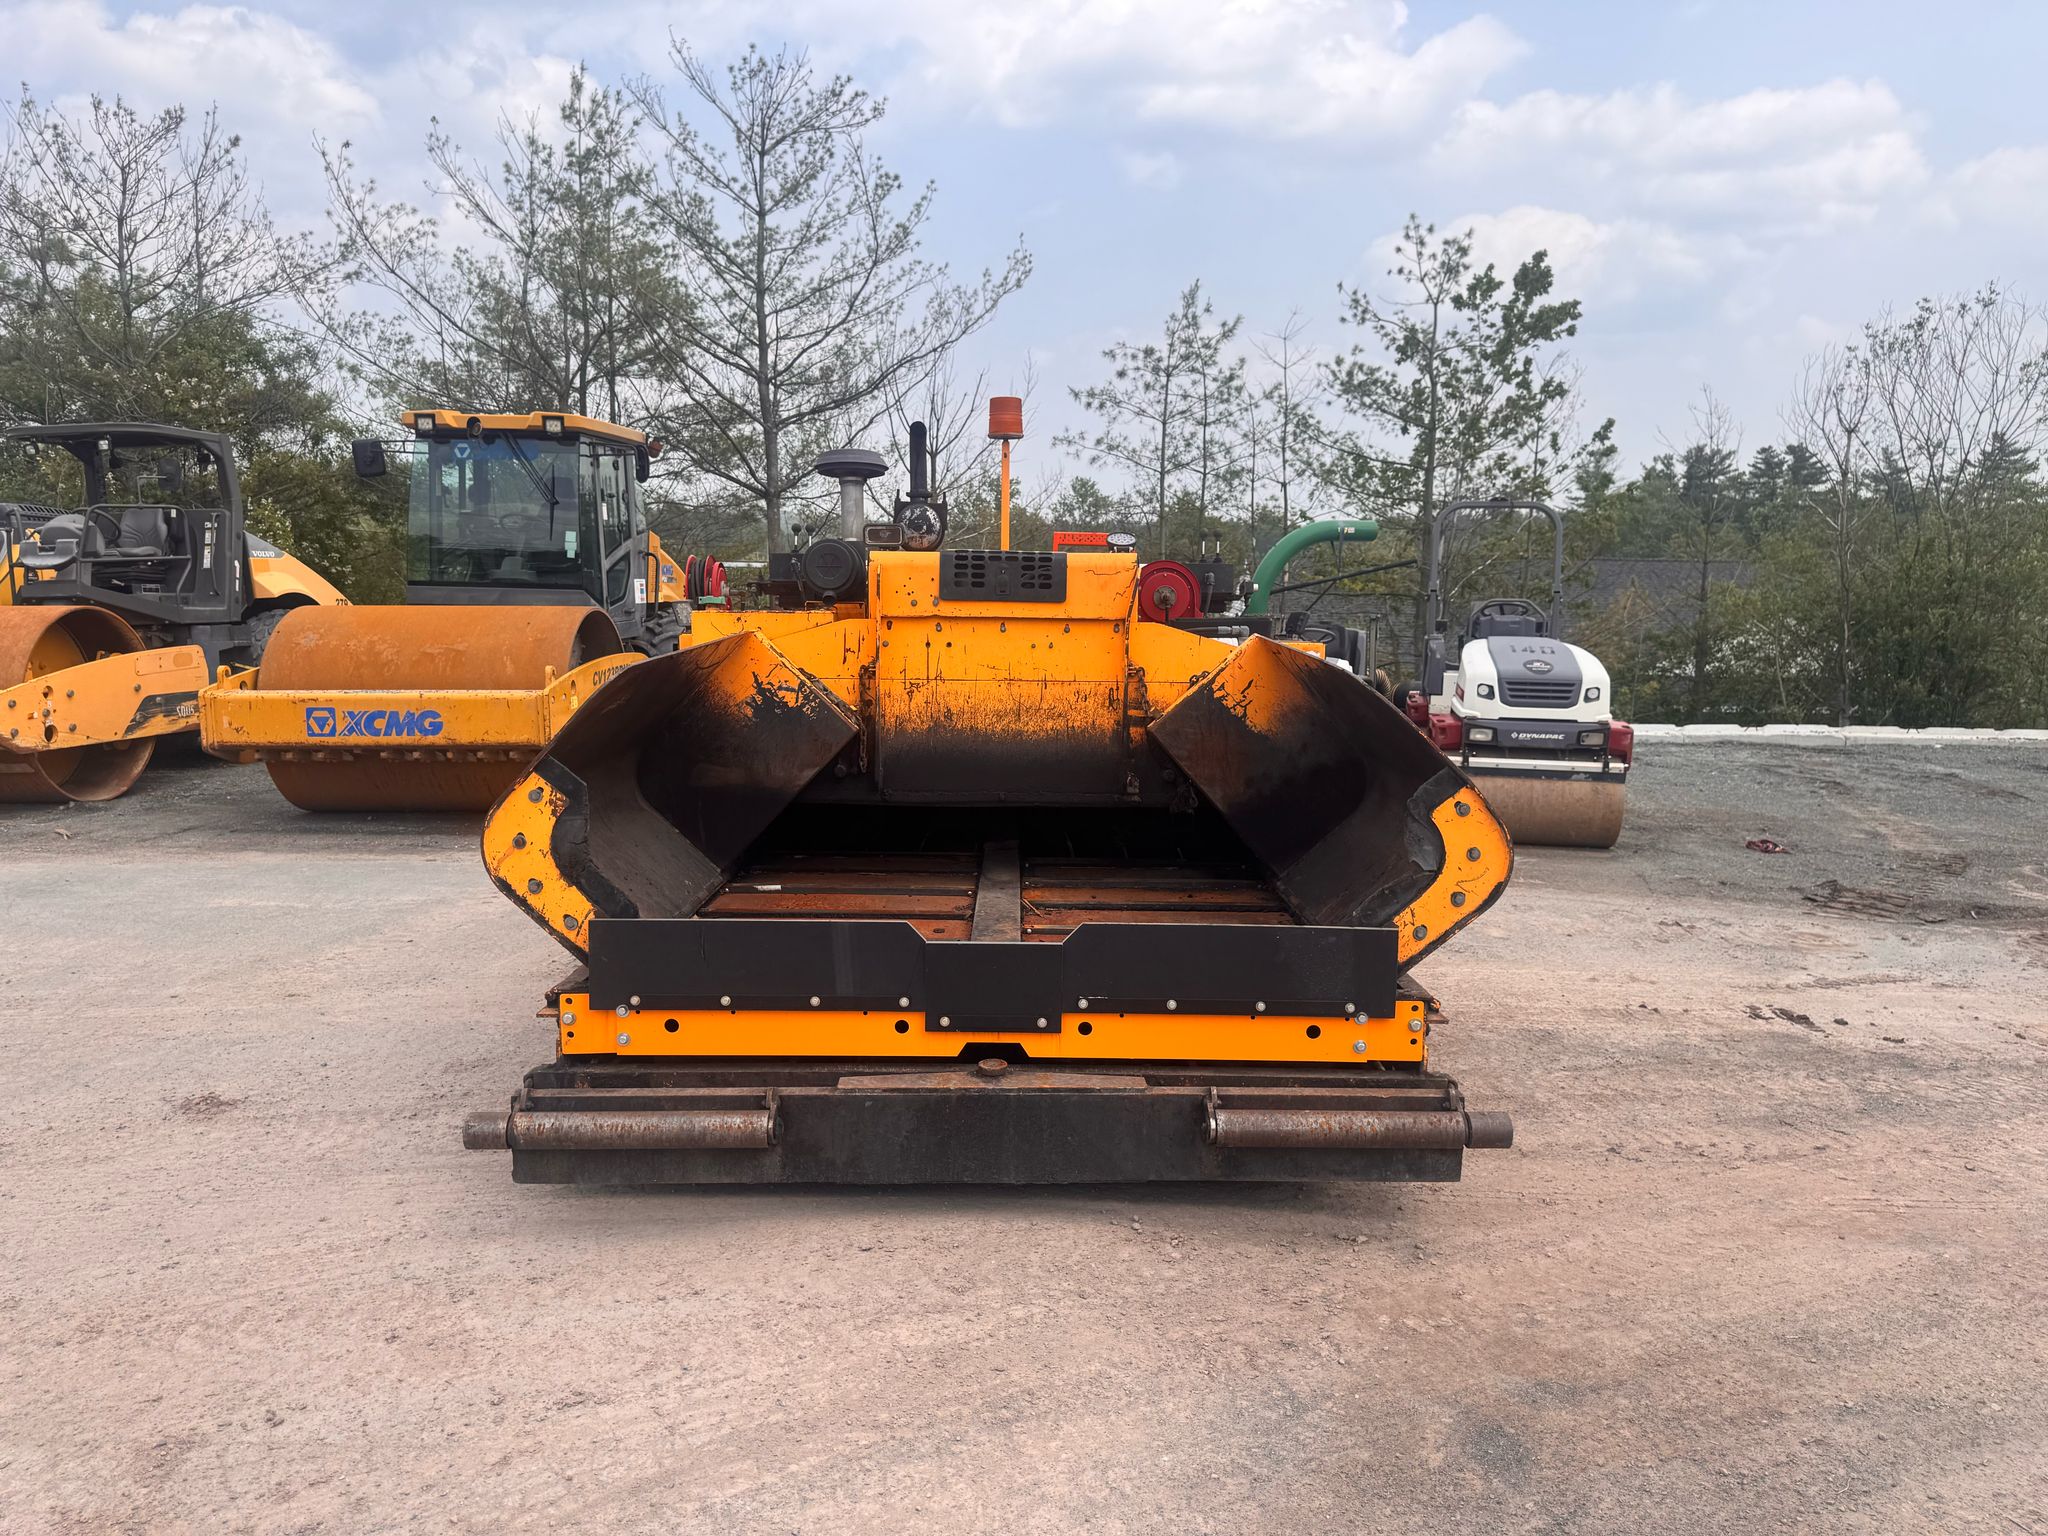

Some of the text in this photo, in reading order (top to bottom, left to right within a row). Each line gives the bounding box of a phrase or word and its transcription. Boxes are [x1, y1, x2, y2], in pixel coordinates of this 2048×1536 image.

[251, 550, 275, 558] VOLVO
[338, 709, 444, 737] XCMG
[1518, 732, 1566, 740] DYNAPAC
